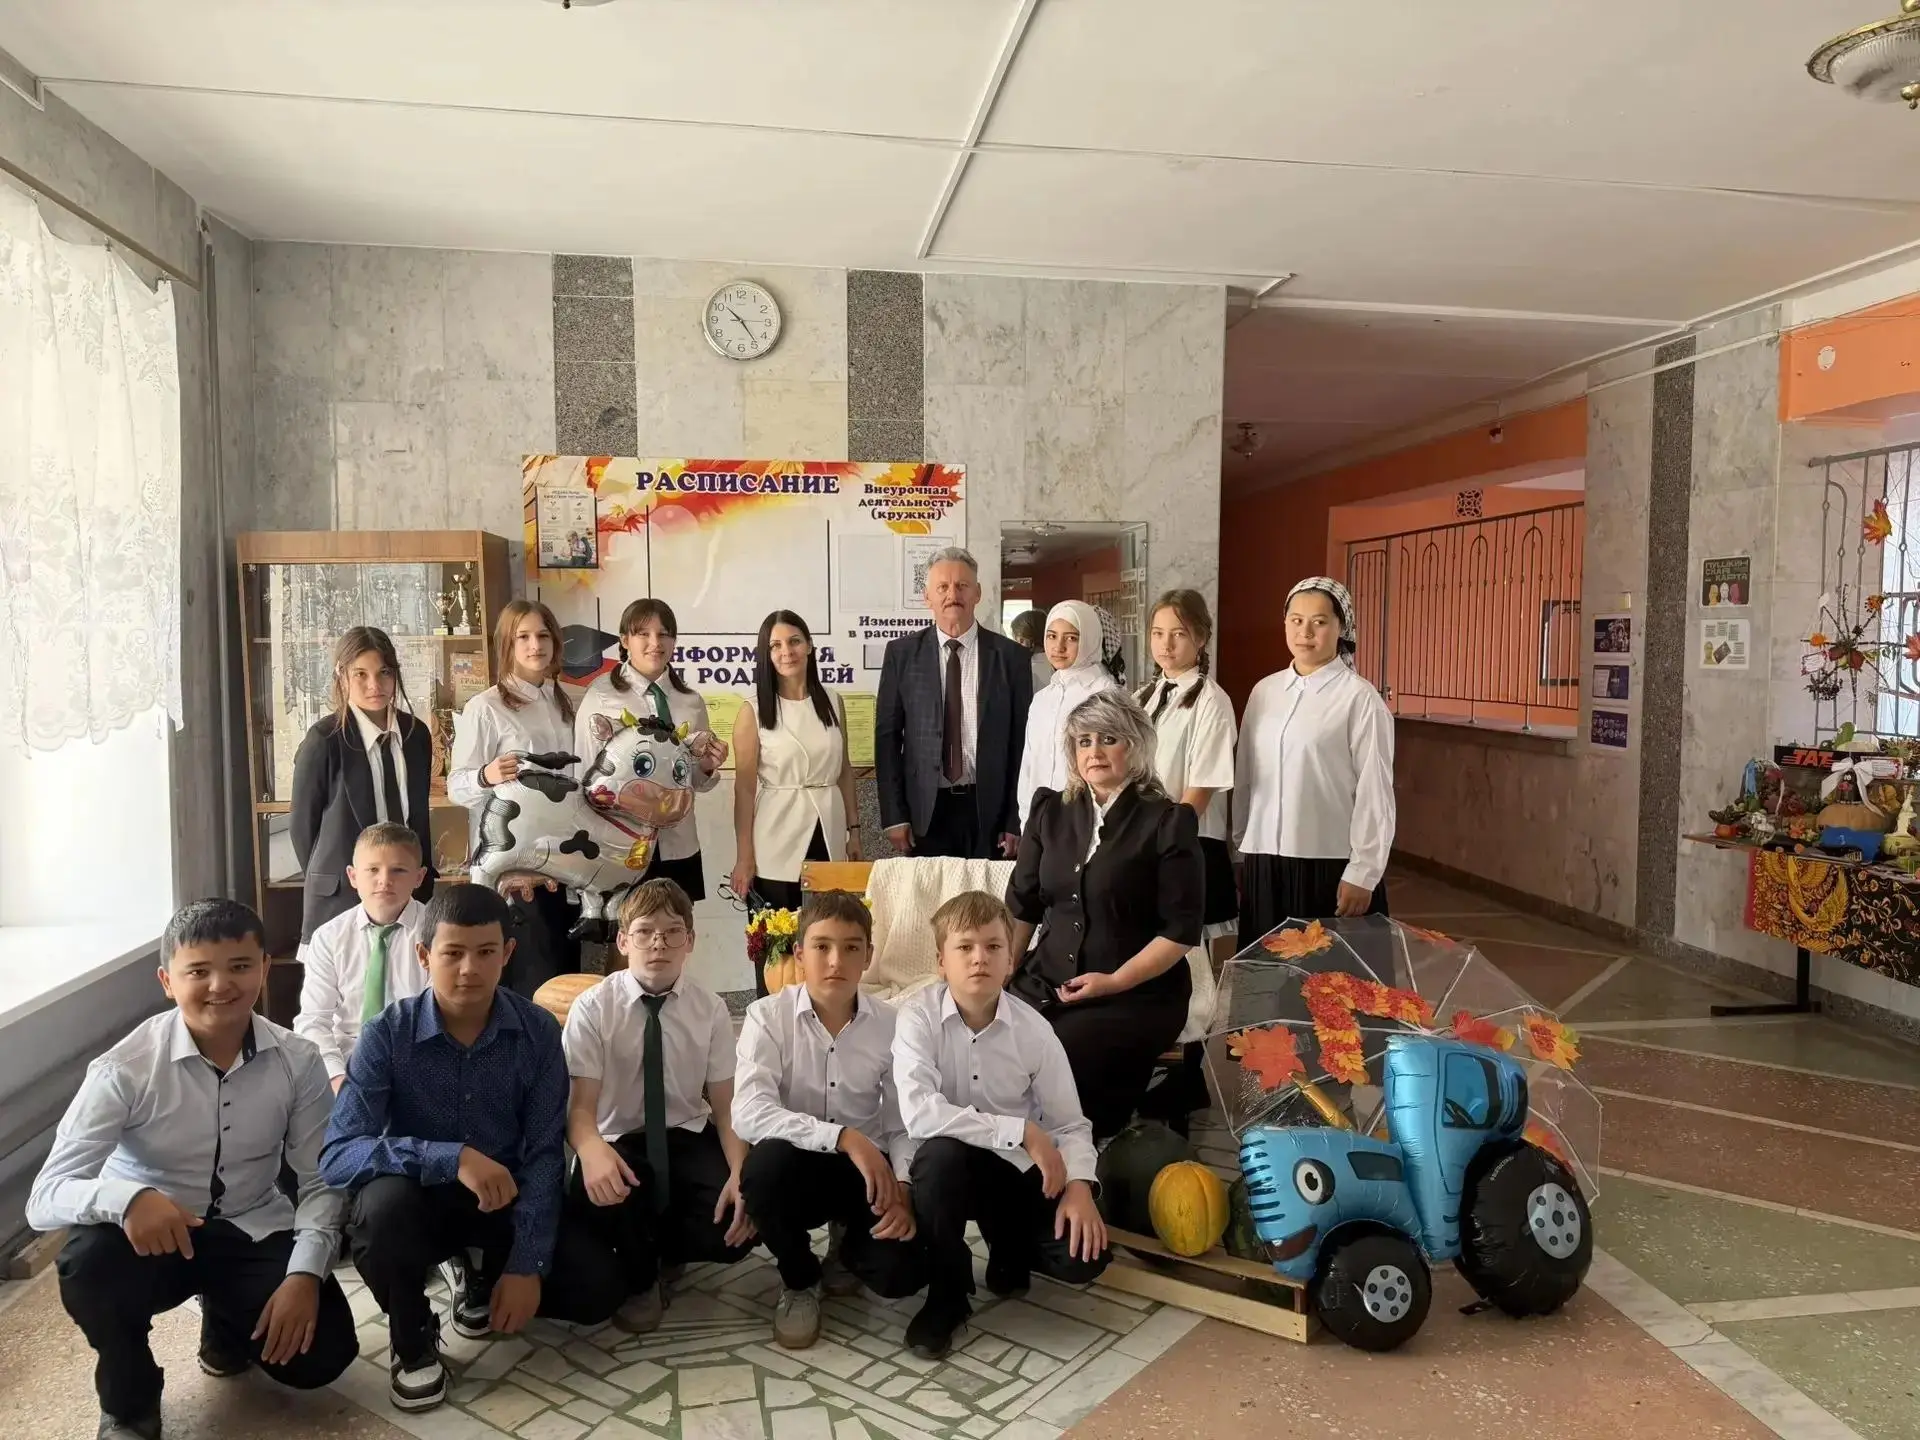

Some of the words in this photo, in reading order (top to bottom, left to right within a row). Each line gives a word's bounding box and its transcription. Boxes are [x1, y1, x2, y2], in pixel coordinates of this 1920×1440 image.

[724, 293, 732, 303] 11
[736, 290, 747, 299] 12
[714, 302, 725, 312] 10
[760, 305, 768, 314] 2
[711, 316, 719, 324] 9
[764, 319, 772, 327] 3
[715, 329, 723, 338] 8
[725, 339, 732, 348] 7
[737, 343, 746, 352] 6
[750, 340, 758, 349] 5
[635, 472, 840, 494] РАСПИСАНИЕ
[864, 484, 949, 495] Внеурочная
[858, 498, 954, 508] деятельность
[871, 508, 942, 520] (кружки)
[858, 616, 933, 627] Изменени
[848, 630, 857, 638] в
[669, 646, 836, 663] НФОРМЯ
[697, 663, 855, 686] РОДЕЙ
